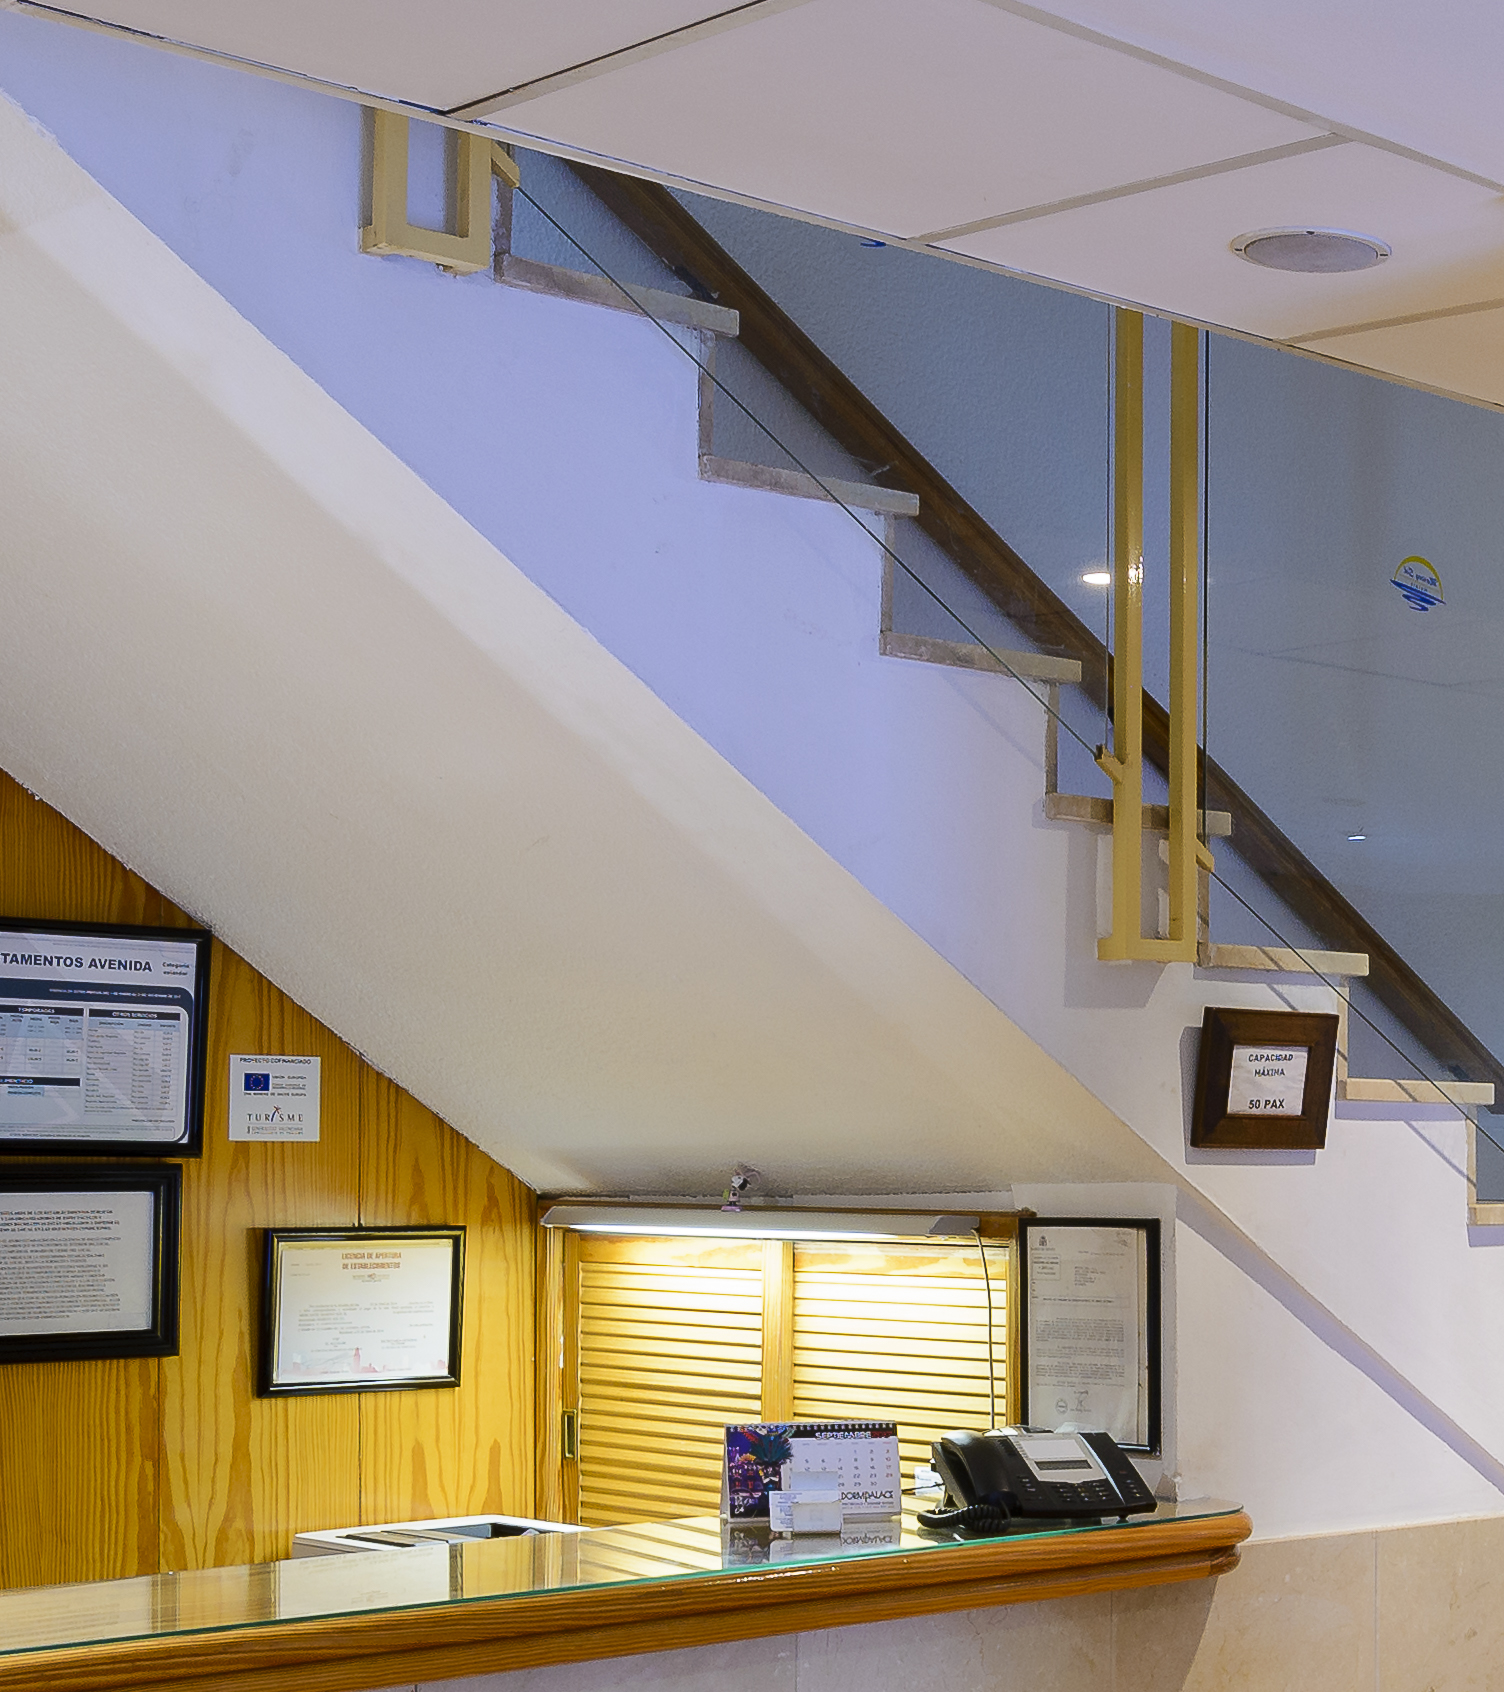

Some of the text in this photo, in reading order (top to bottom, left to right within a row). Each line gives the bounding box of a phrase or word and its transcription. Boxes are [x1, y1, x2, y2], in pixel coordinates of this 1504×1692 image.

[88, 958, 152, 972] AVENIDA
[1248, 1054, 1294, 1062] CAPACIDAD
[1254, 1066, 1285, 1077] MÁXIMA
[1248, 1098, 1285, 1109] 50 PAX
[247, 1106, 304, 1122] TURISME
[816, 1431, 872, 1440] SEPTIEMBRE
